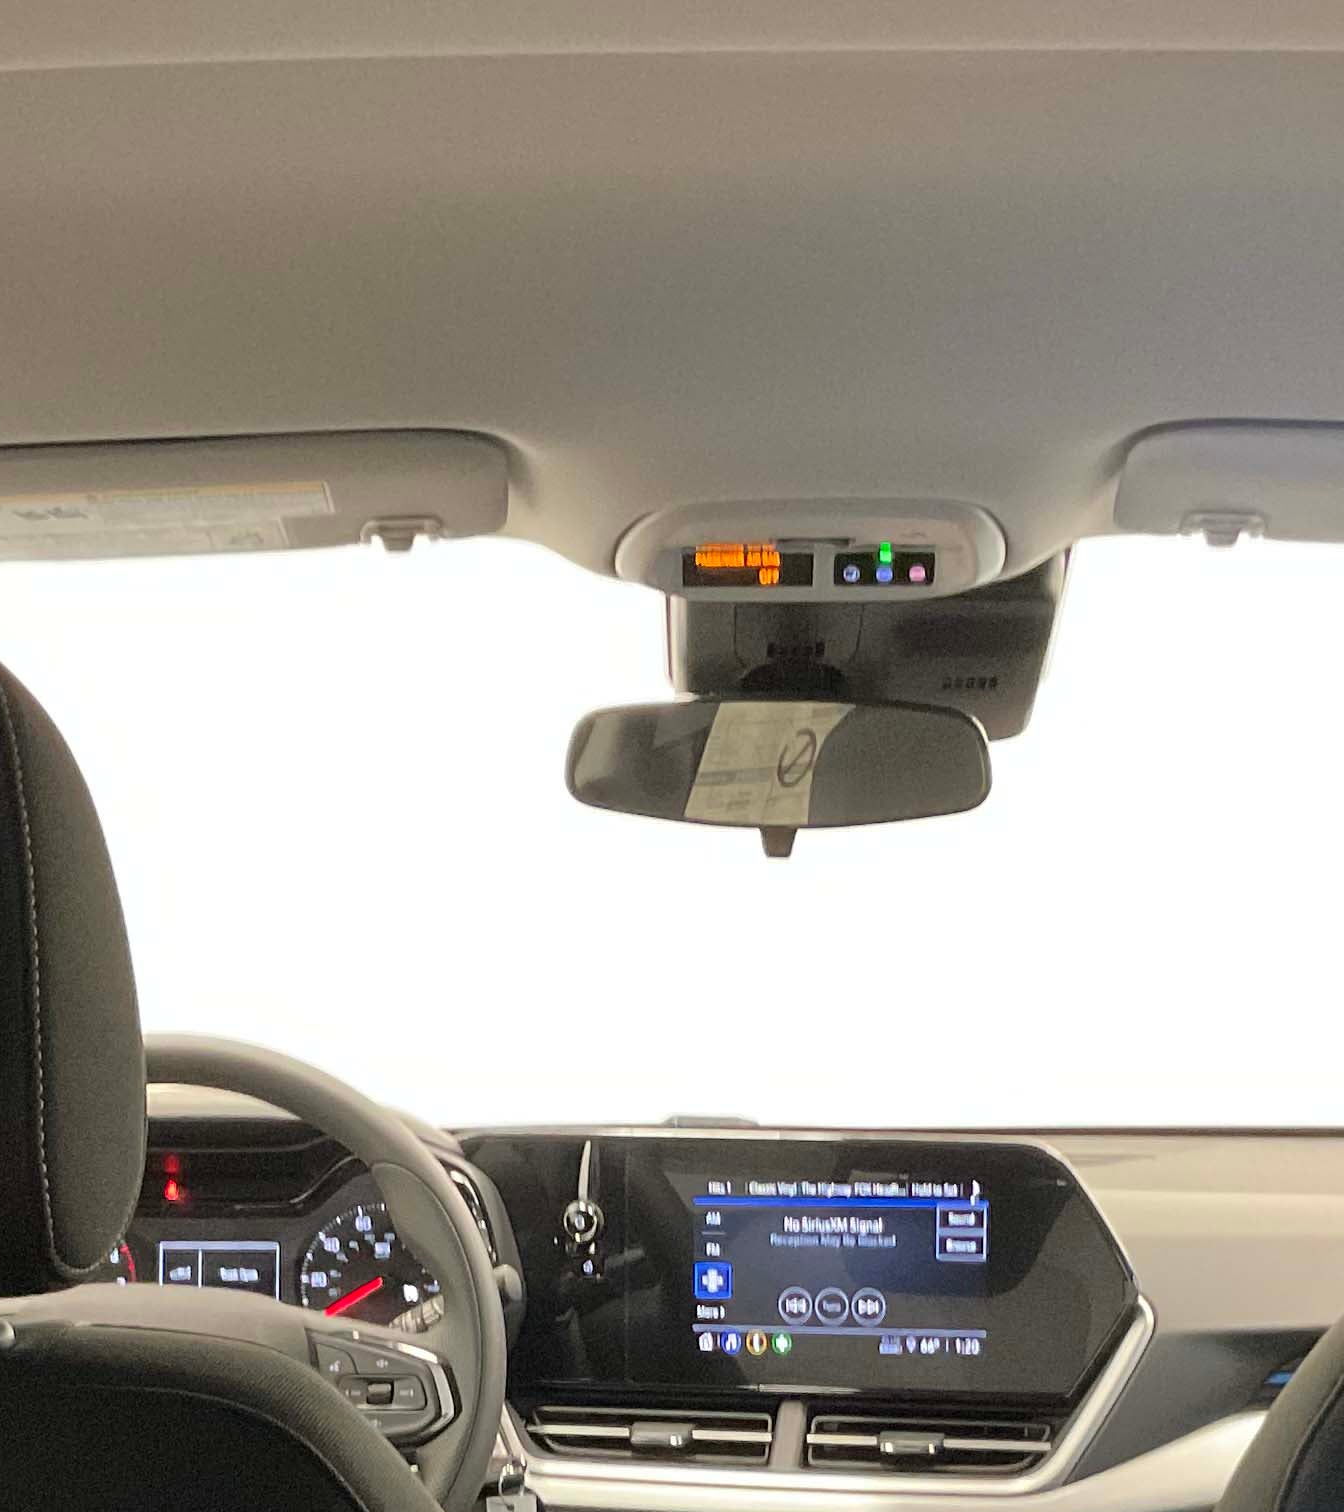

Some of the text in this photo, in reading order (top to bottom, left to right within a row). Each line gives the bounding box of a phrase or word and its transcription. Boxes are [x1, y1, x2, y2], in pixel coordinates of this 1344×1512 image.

[784, 1215, 883, 1236] No SiriusXM Signal
